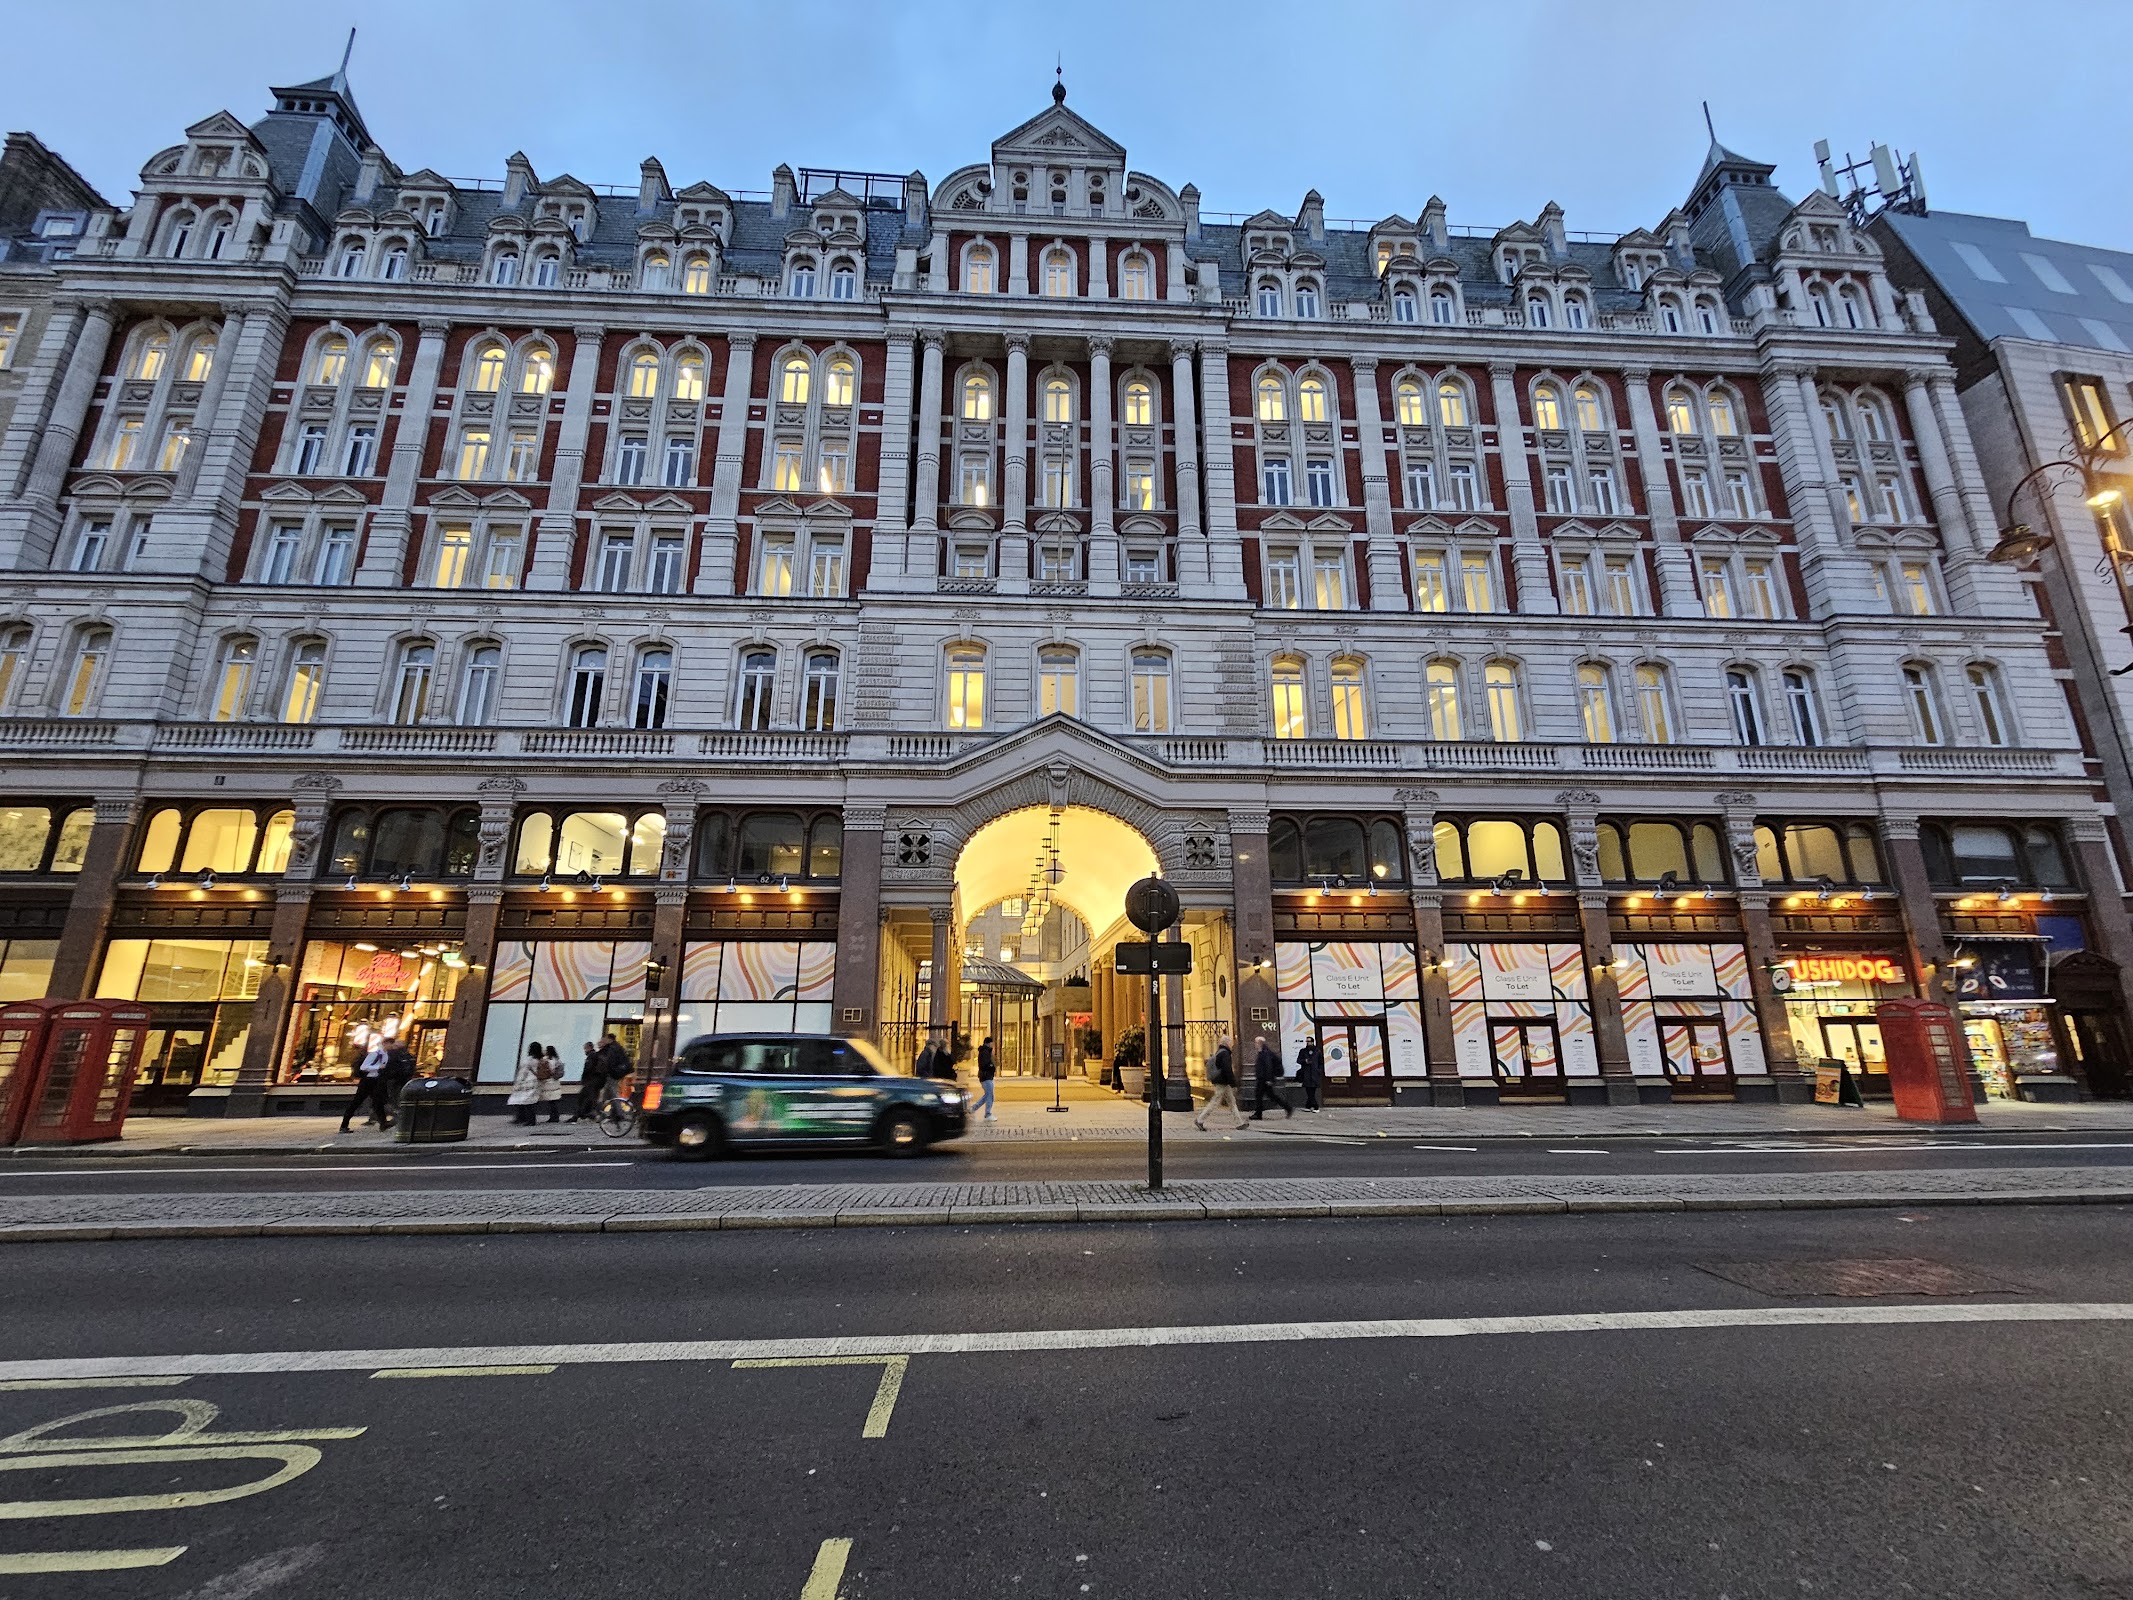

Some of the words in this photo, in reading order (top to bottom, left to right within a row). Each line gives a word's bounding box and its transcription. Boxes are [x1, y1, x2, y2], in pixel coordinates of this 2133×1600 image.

[1503, 879, 1513, 887] 80
[1792, 959, 1895, 981] USHIDOG
[1326, 974, 1346, 982] Class
[1354, 974, 1370, 982] Unit
[1337, 982, 1346, 990] To
[1348, 982, 1361, 990] Let
